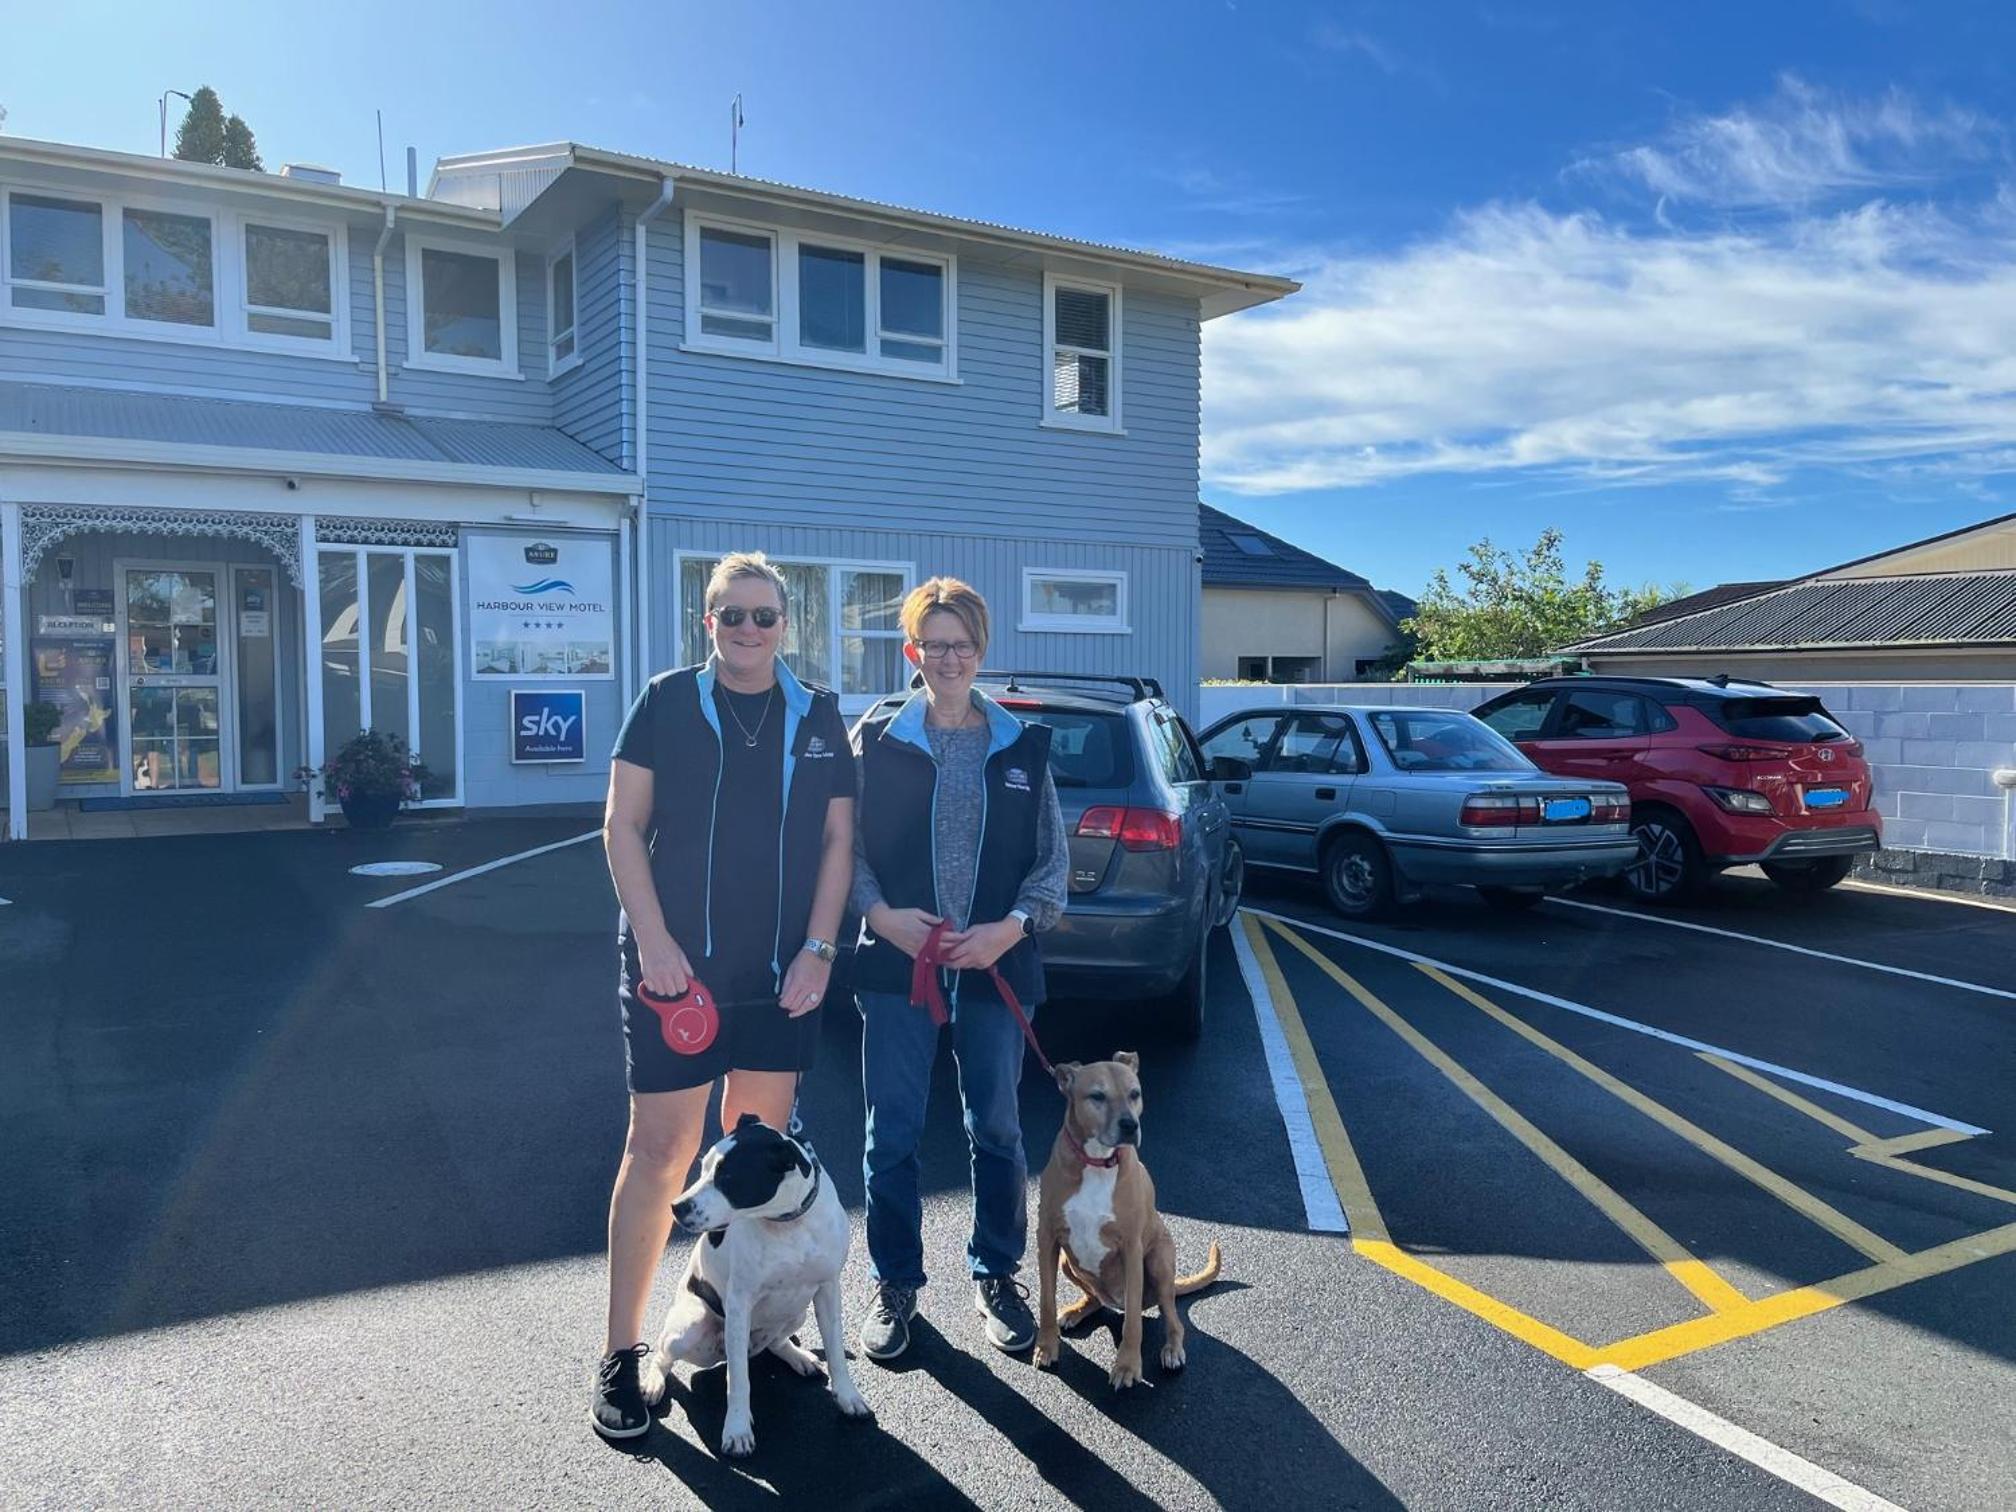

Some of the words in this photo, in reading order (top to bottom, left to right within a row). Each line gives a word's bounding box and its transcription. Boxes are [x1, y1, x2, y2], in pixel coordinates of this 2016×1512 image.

[477, 601, 534, 611] HARBOUR
[538, 602, 566, 612] VIEW
[569, 603, 605, 612] MOTEL
[520, 706, 577, 741] sky
